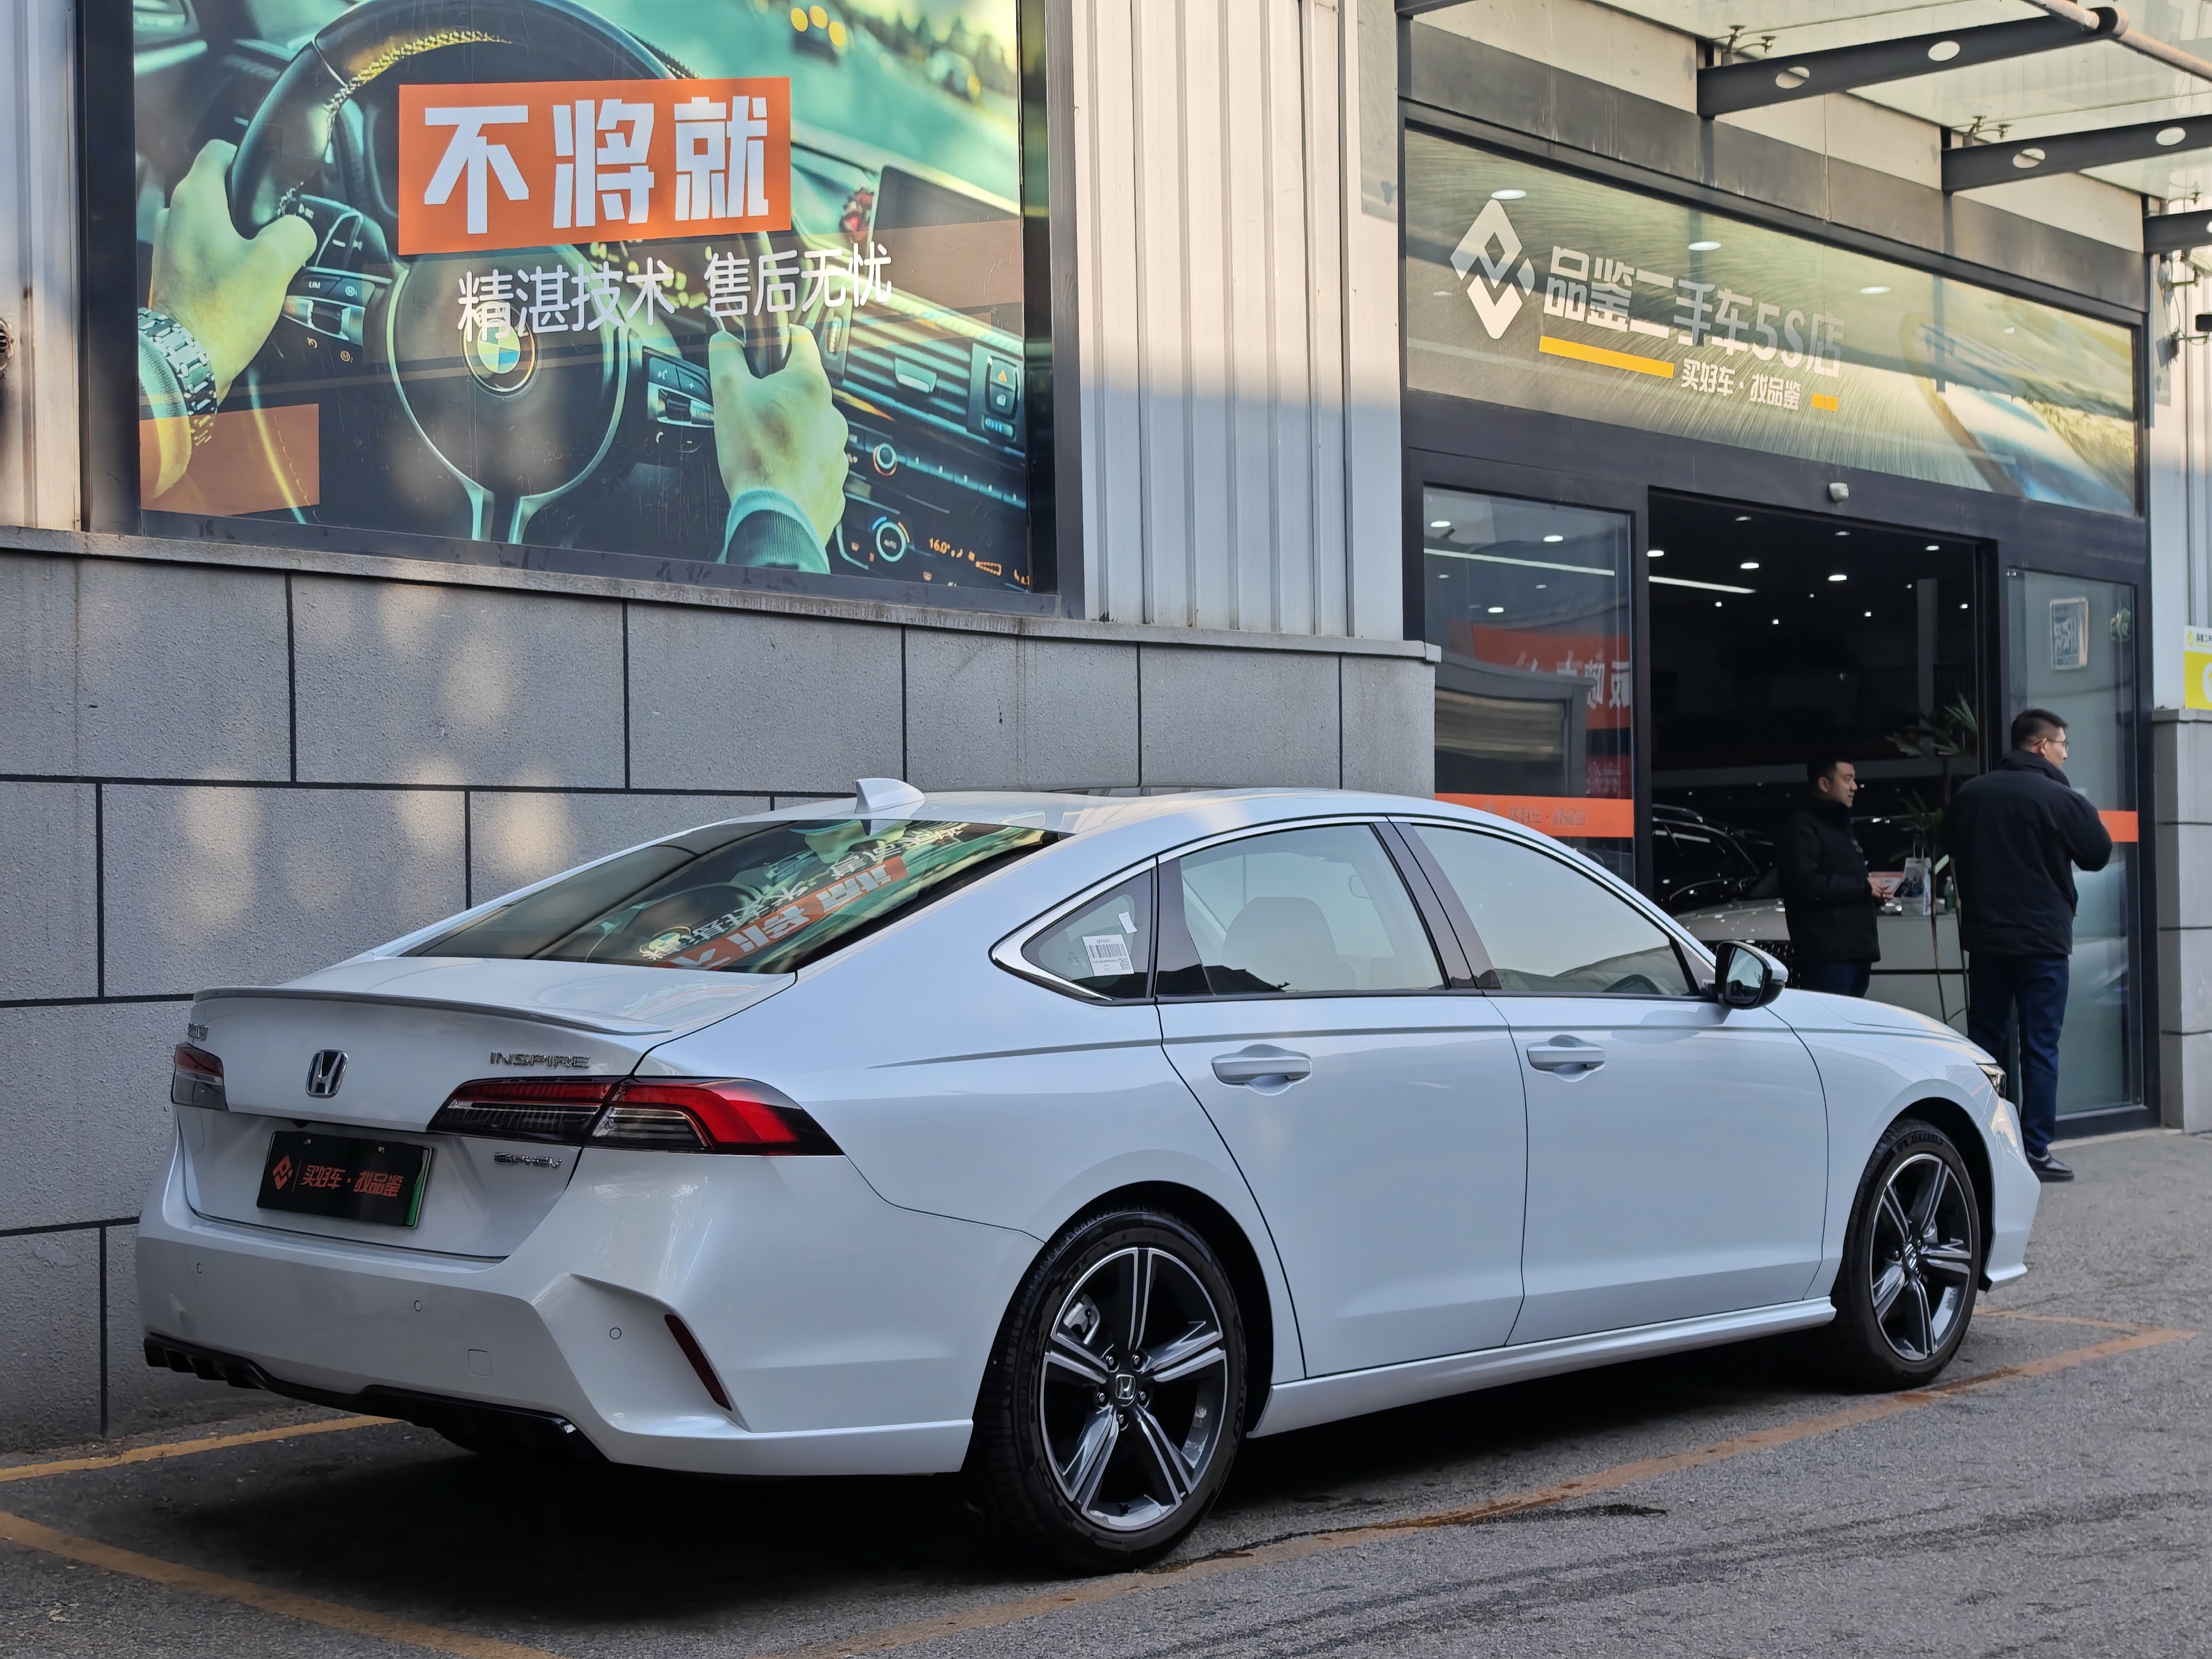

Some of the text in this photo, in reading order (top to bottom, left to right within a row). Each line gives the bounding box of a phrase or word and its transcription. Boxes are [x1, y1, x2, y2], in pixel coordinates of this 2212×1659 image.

[424, 96, 769, 235] 不将就
[457, 241, 893, 343] 精湛技术 售后无忧
[1543, 245, 1846, 379] 品鉴二手车5S店
[490, 1051, 591, 1068] INSPIRE
